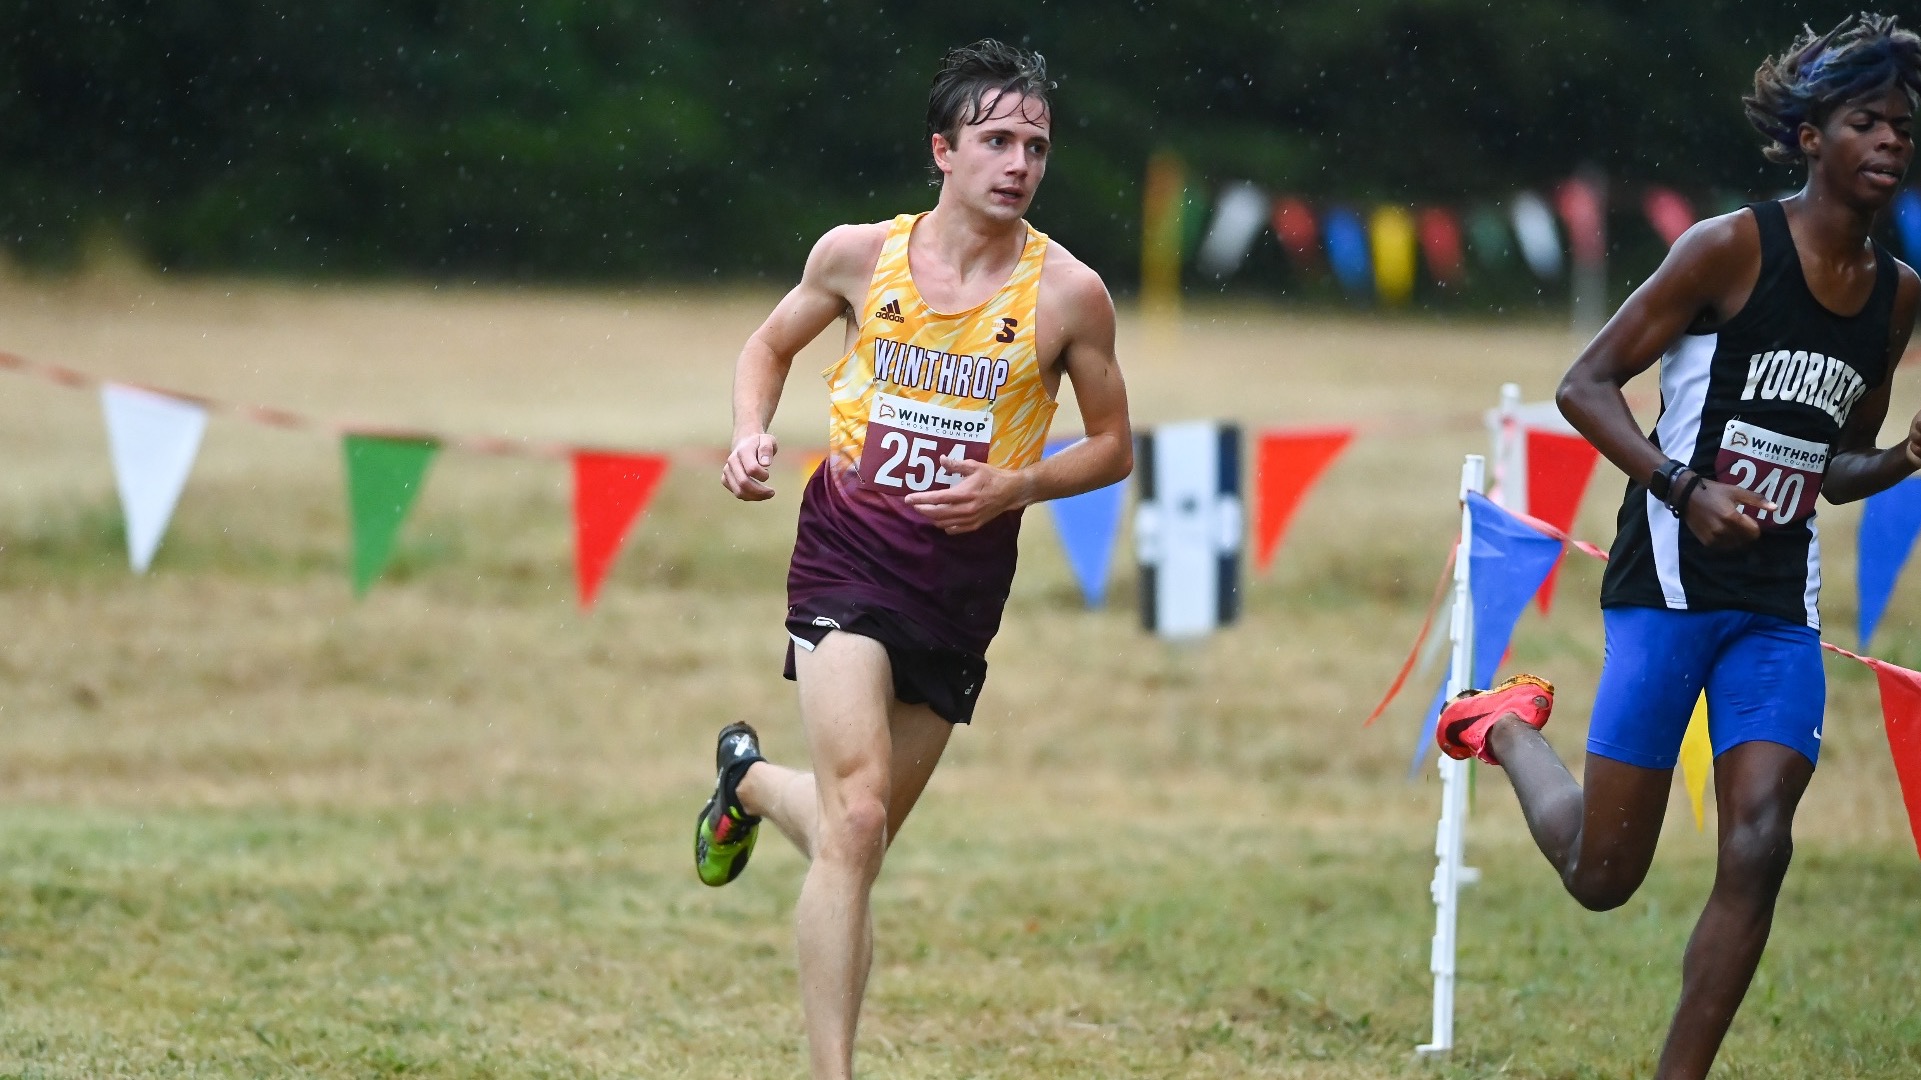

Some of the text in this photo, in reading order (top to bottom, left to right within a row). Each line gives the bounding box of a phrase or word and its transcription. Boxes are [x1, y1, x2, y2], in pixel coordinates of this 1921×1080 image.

[875, 311, 905, 324] adidas
[874, 337, 1010, 401] WINTHROP
[1740, 350, 1867, 429] VOORHEES
[898, 408, 986, 433] WINTHROP
[900, 421, 980, 439] CROSS COUNTRY
[1752, 436, 1826, 464] WINTHROP
[1752, 449, 1819, 470] CROSS COUNTRY
